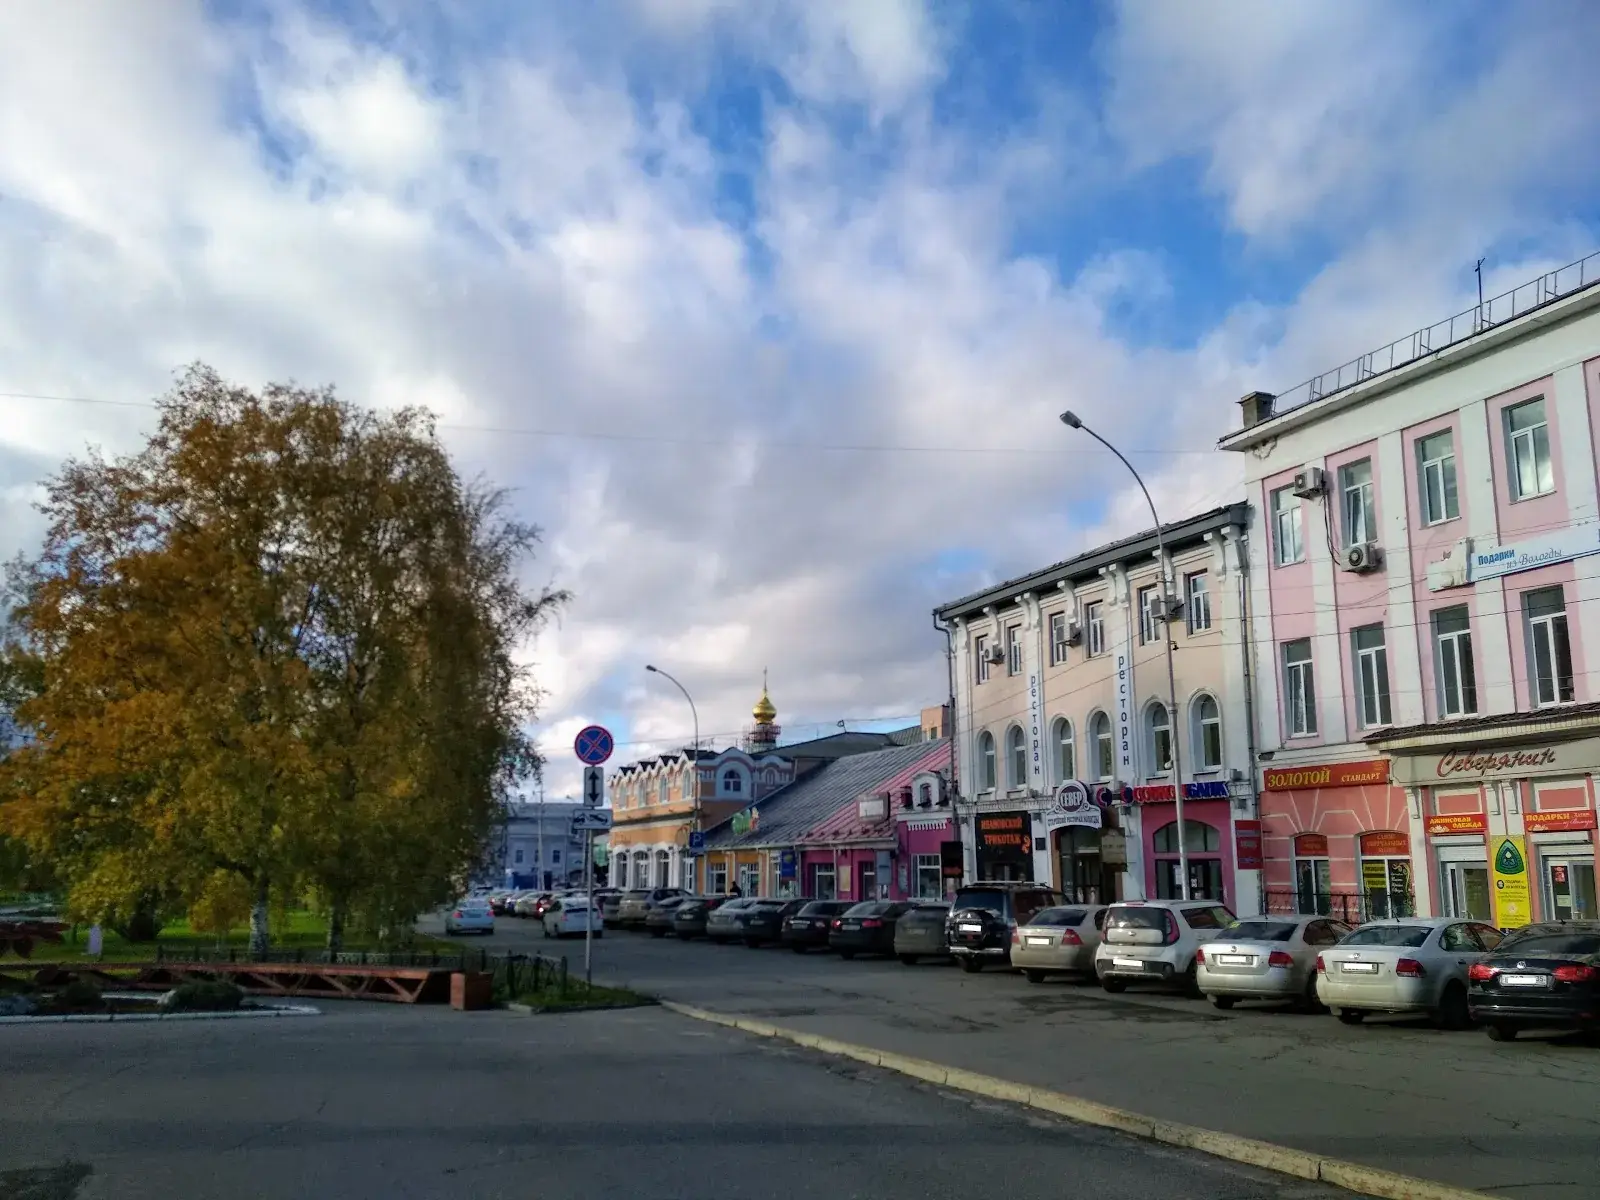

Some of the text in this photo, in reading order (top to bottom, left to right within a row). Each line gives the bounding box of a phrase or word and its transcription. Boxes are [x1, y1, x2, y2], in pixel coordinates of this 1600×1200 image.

[1477, 548, 1516, 566] Подарки
[1519, 547, 1563, 565] Вологды
[1118, 655, 1130, 766] ресторан
[1030, 675, 1040, 775] ресторан
[1436, 746, 1557, 778] Северянин
[1267, 766, 1382, 788] ЗОЛОТОЙ СТАНДАРТ
[1059, 791, 1083, 807] СЕВЕР
[1452, 821, 1482, 829] ОДЕЖДА
[1525, 812, 1571, 822] ПОДАРКИ
[693, 833, 702, 846] P
[984, 833, 1022, 845] ТРИКОТАЖ
